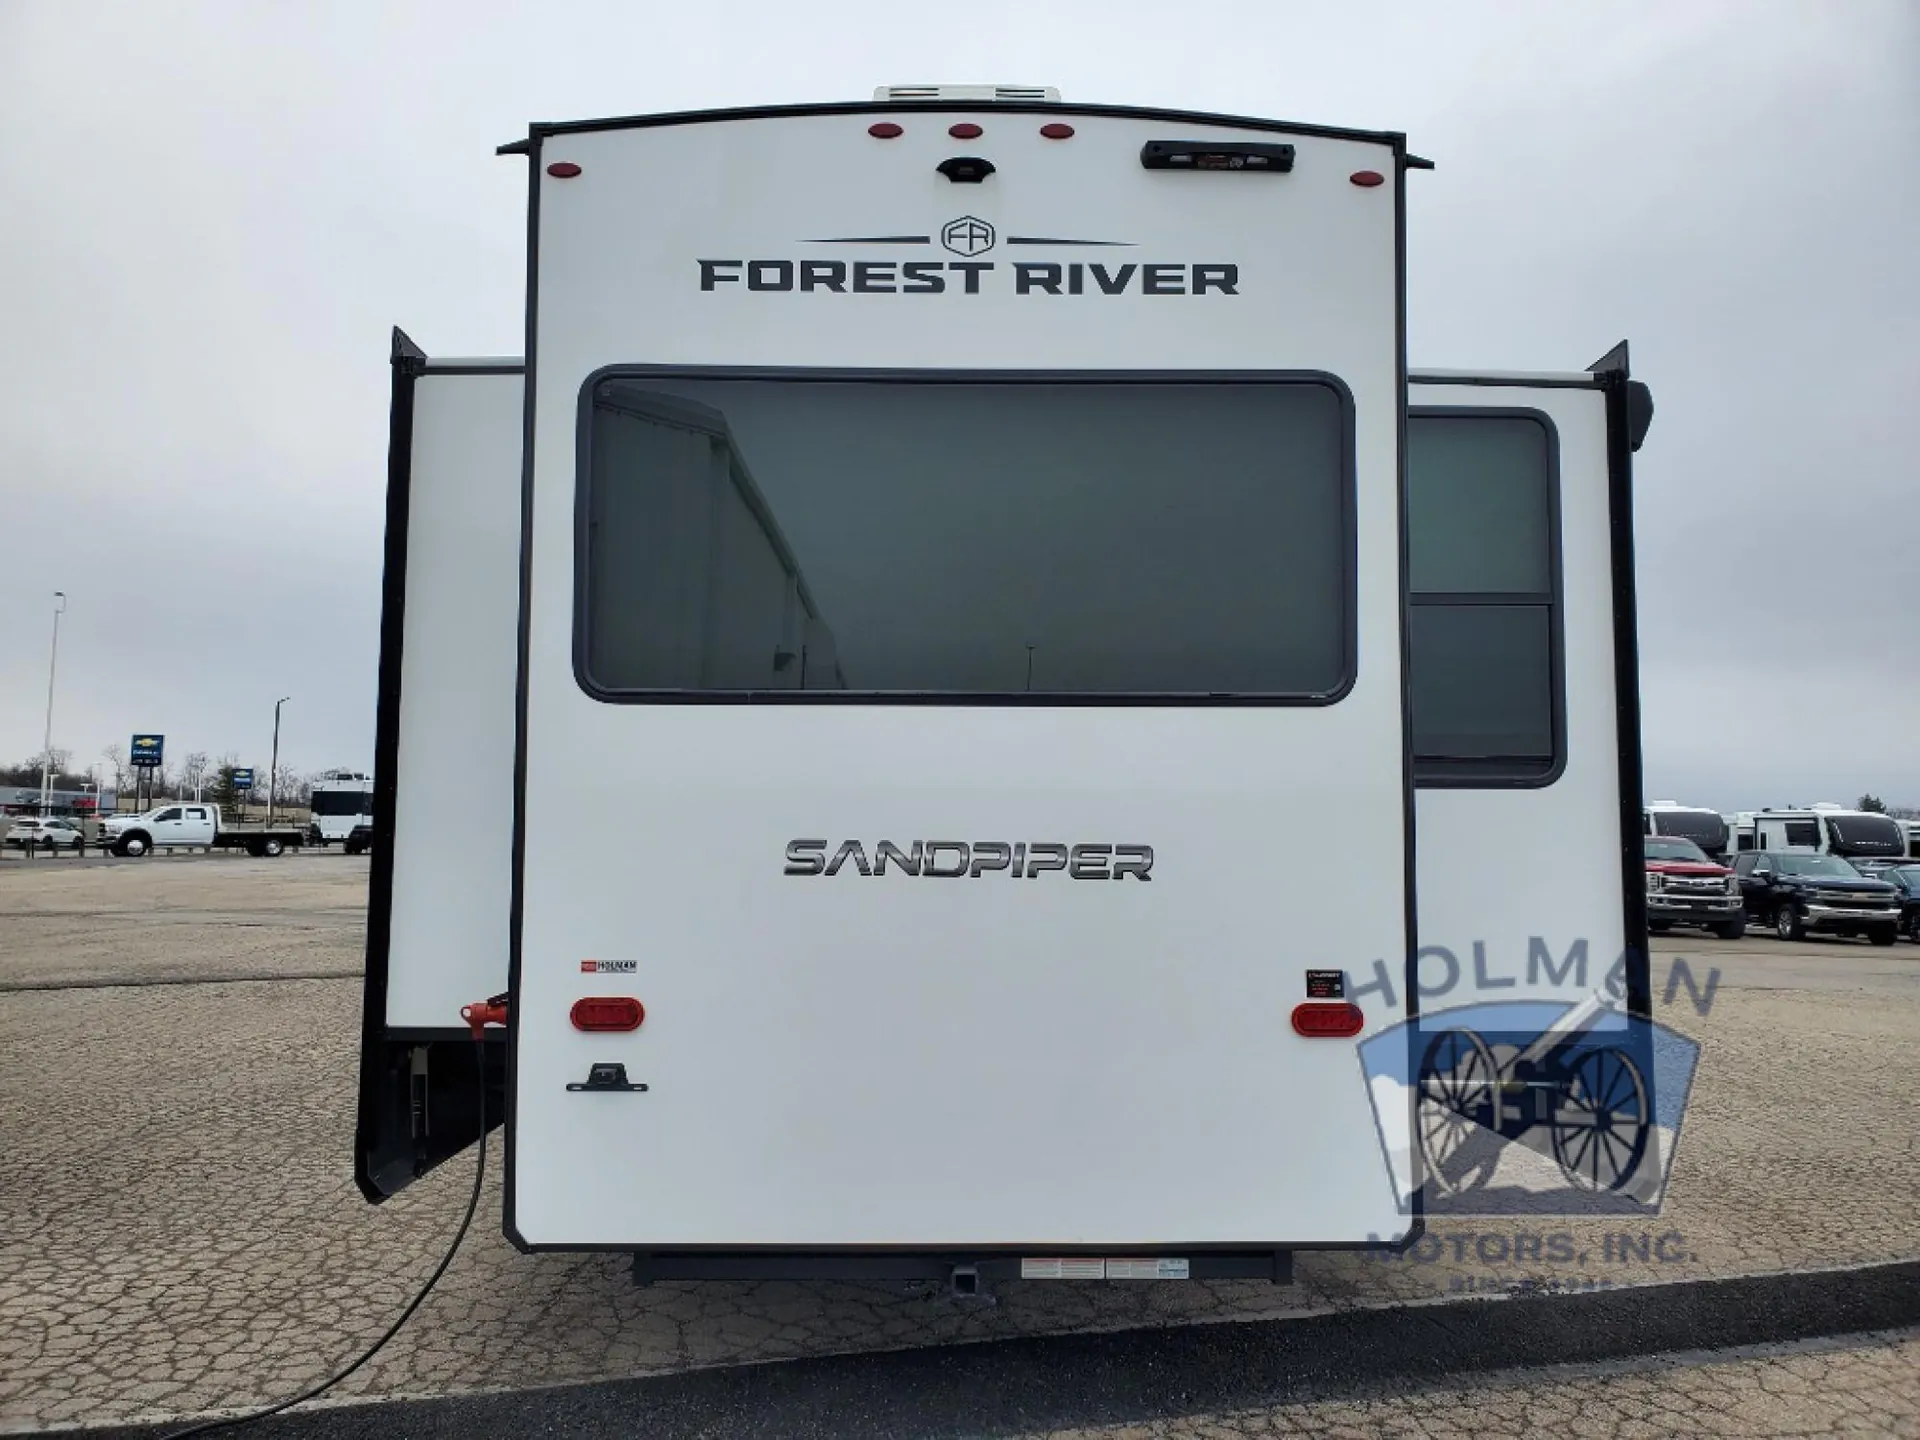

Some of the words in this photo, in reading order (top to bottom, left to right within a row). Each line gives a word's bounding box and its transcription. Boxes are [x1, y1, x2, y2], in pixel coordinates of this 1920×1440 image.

[947, 221, 990, 252] FR
[695, 258, 995, 294] FOREST
[1011, 262, 1241, 296] RIVER
[783, 839, 1155, 882] SANDPIPER
